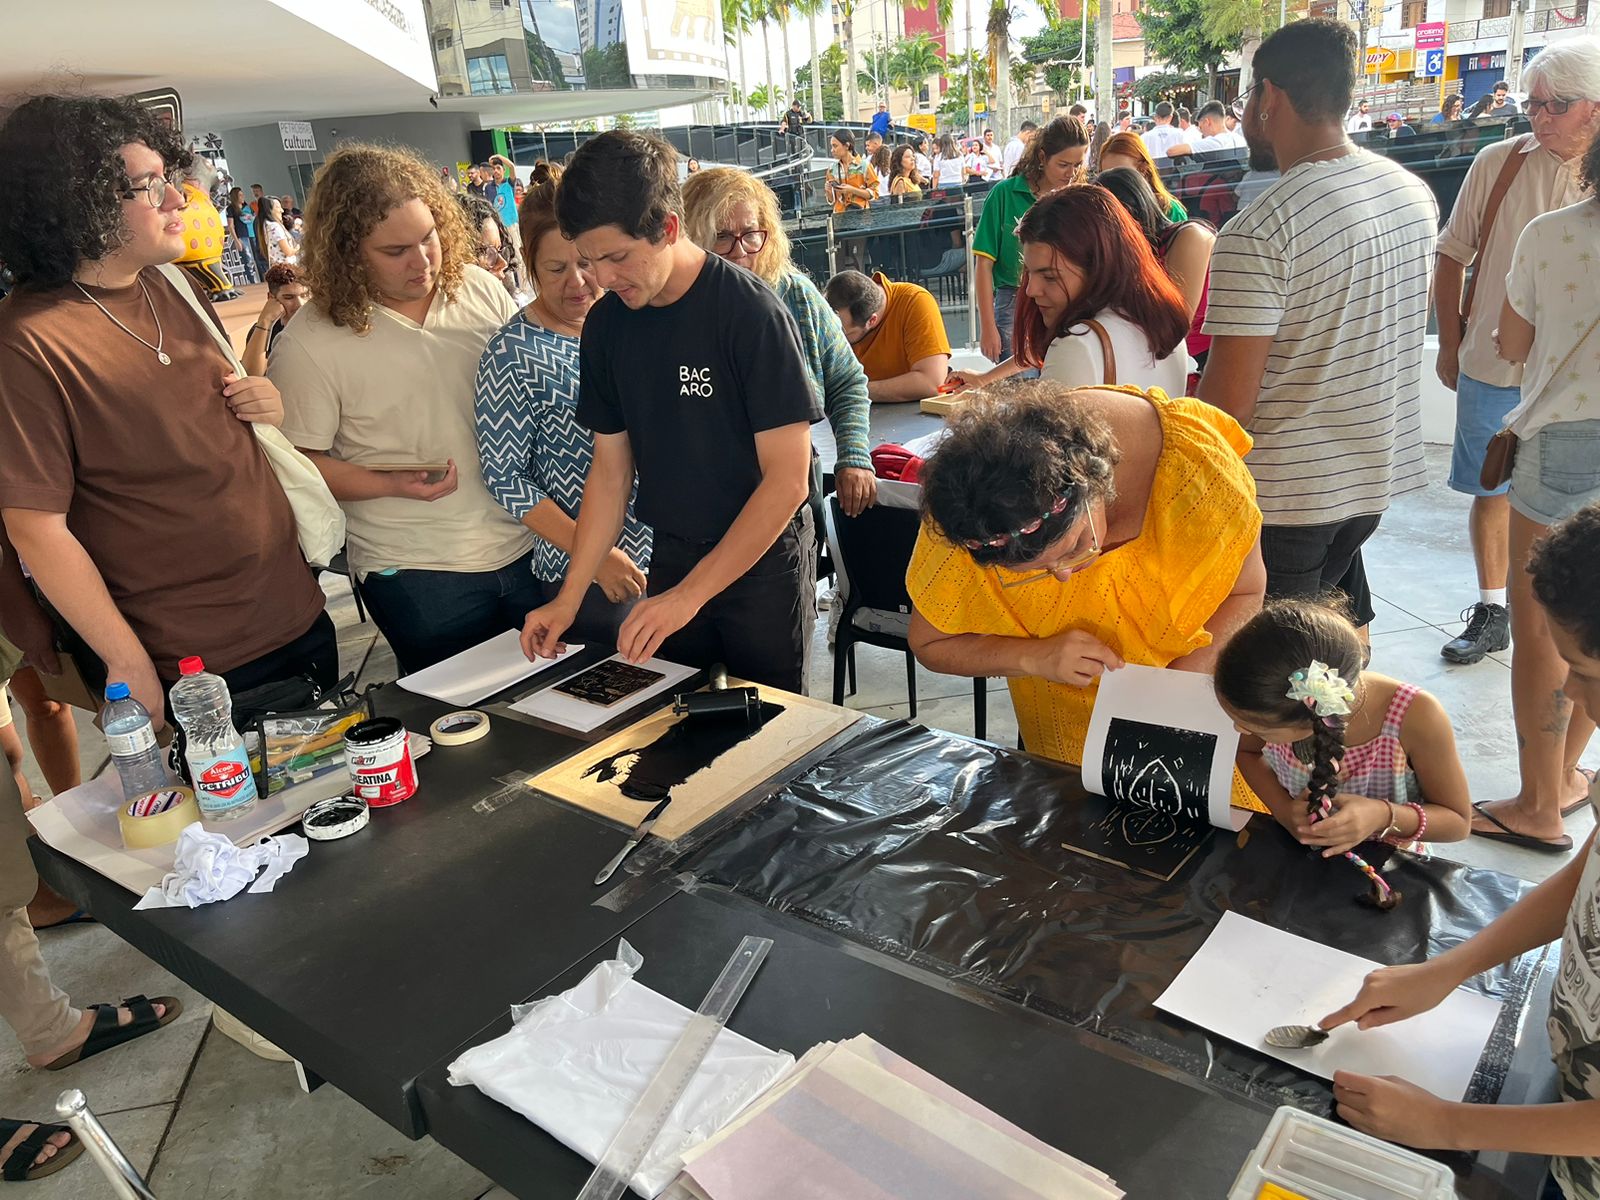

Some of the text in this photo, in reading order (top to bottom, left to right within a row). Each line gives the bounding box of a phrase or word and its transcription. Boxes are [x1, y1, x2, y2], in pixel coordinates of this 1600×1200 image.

[1469, 57, 1478, 70] FIT
[284, 135, 314, 148] cultural
[680, 365, 710, 381] BAC
[680, 383, 713, 397] ARO
